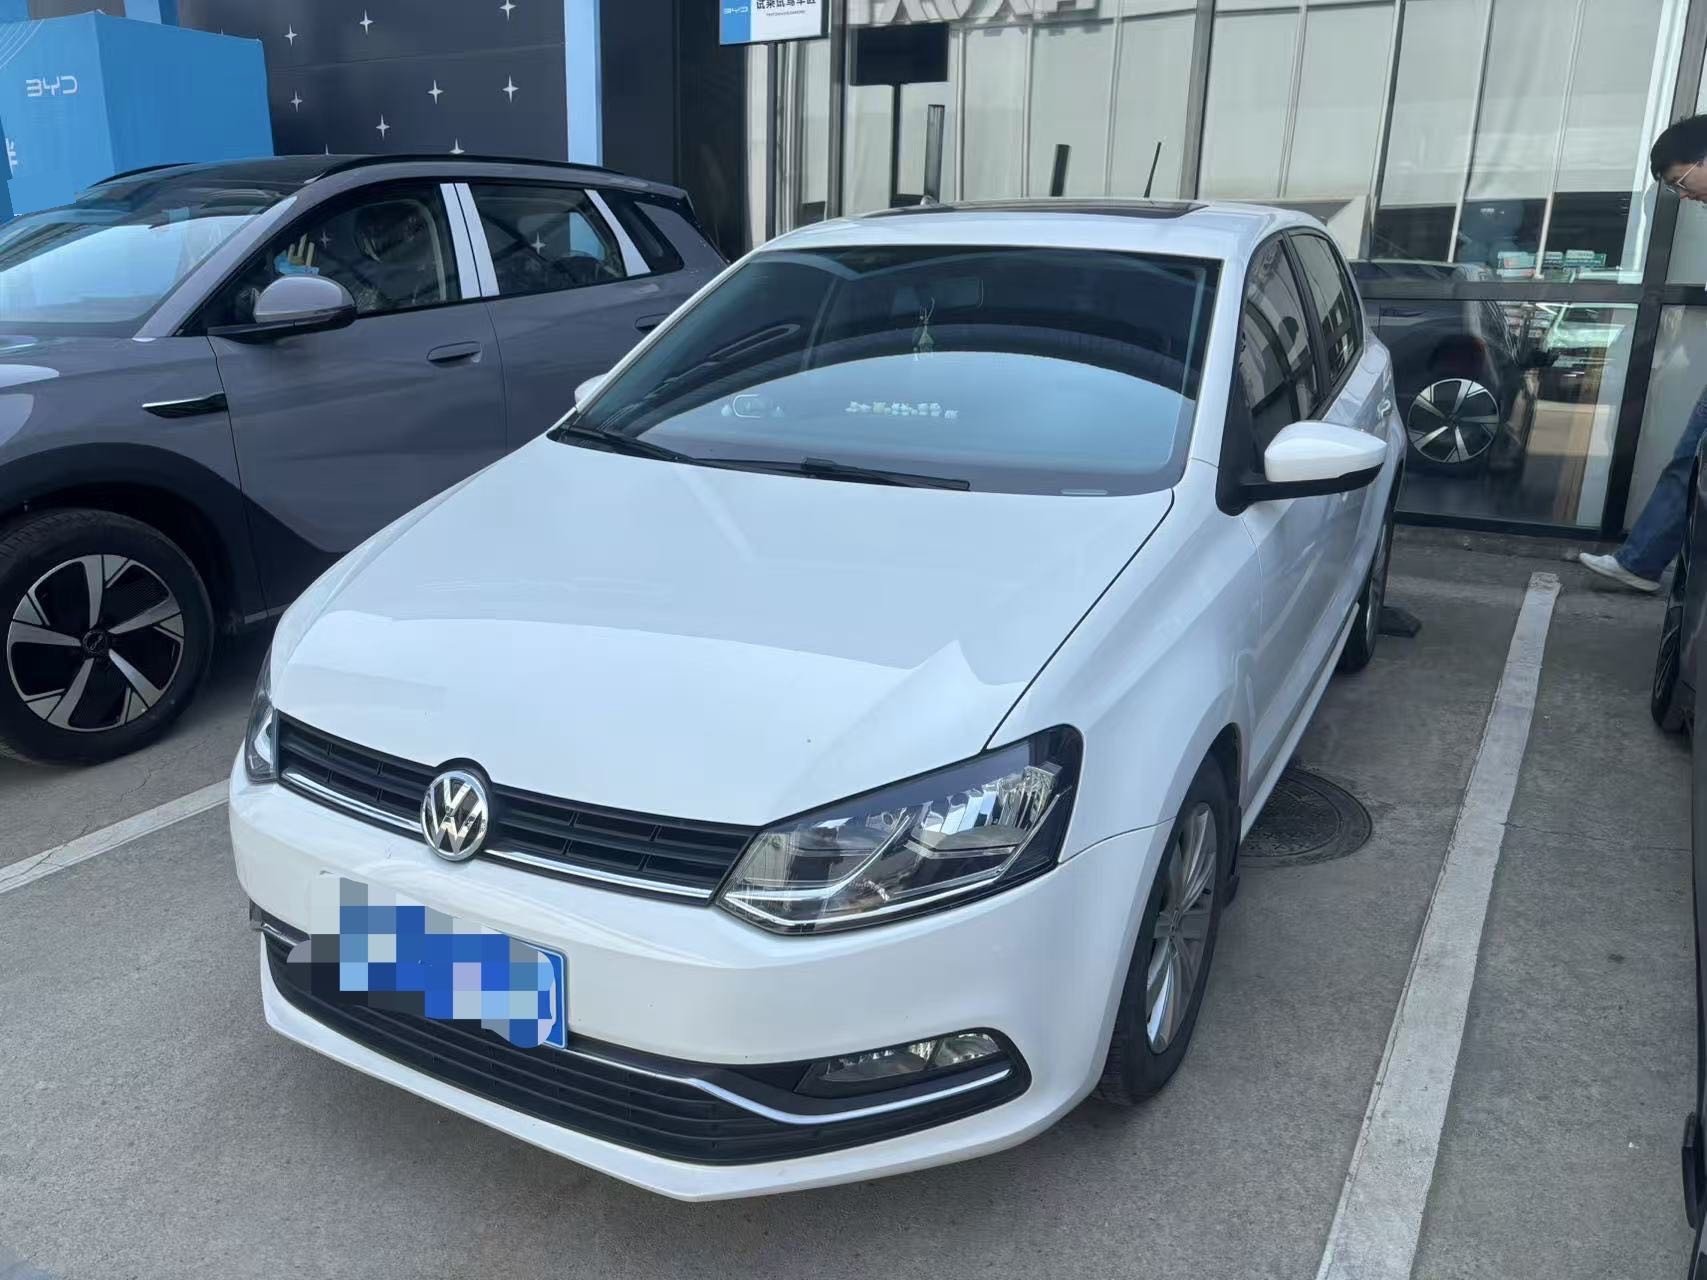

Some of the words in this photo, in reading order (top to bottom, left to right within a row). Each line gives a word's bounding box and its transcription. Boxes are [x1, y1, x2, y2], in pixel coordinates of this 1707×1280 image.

[723, 6, 748, 15] BYD
[26, 75, 78, 97] BYD
[422, 770, 488, 860] VW
